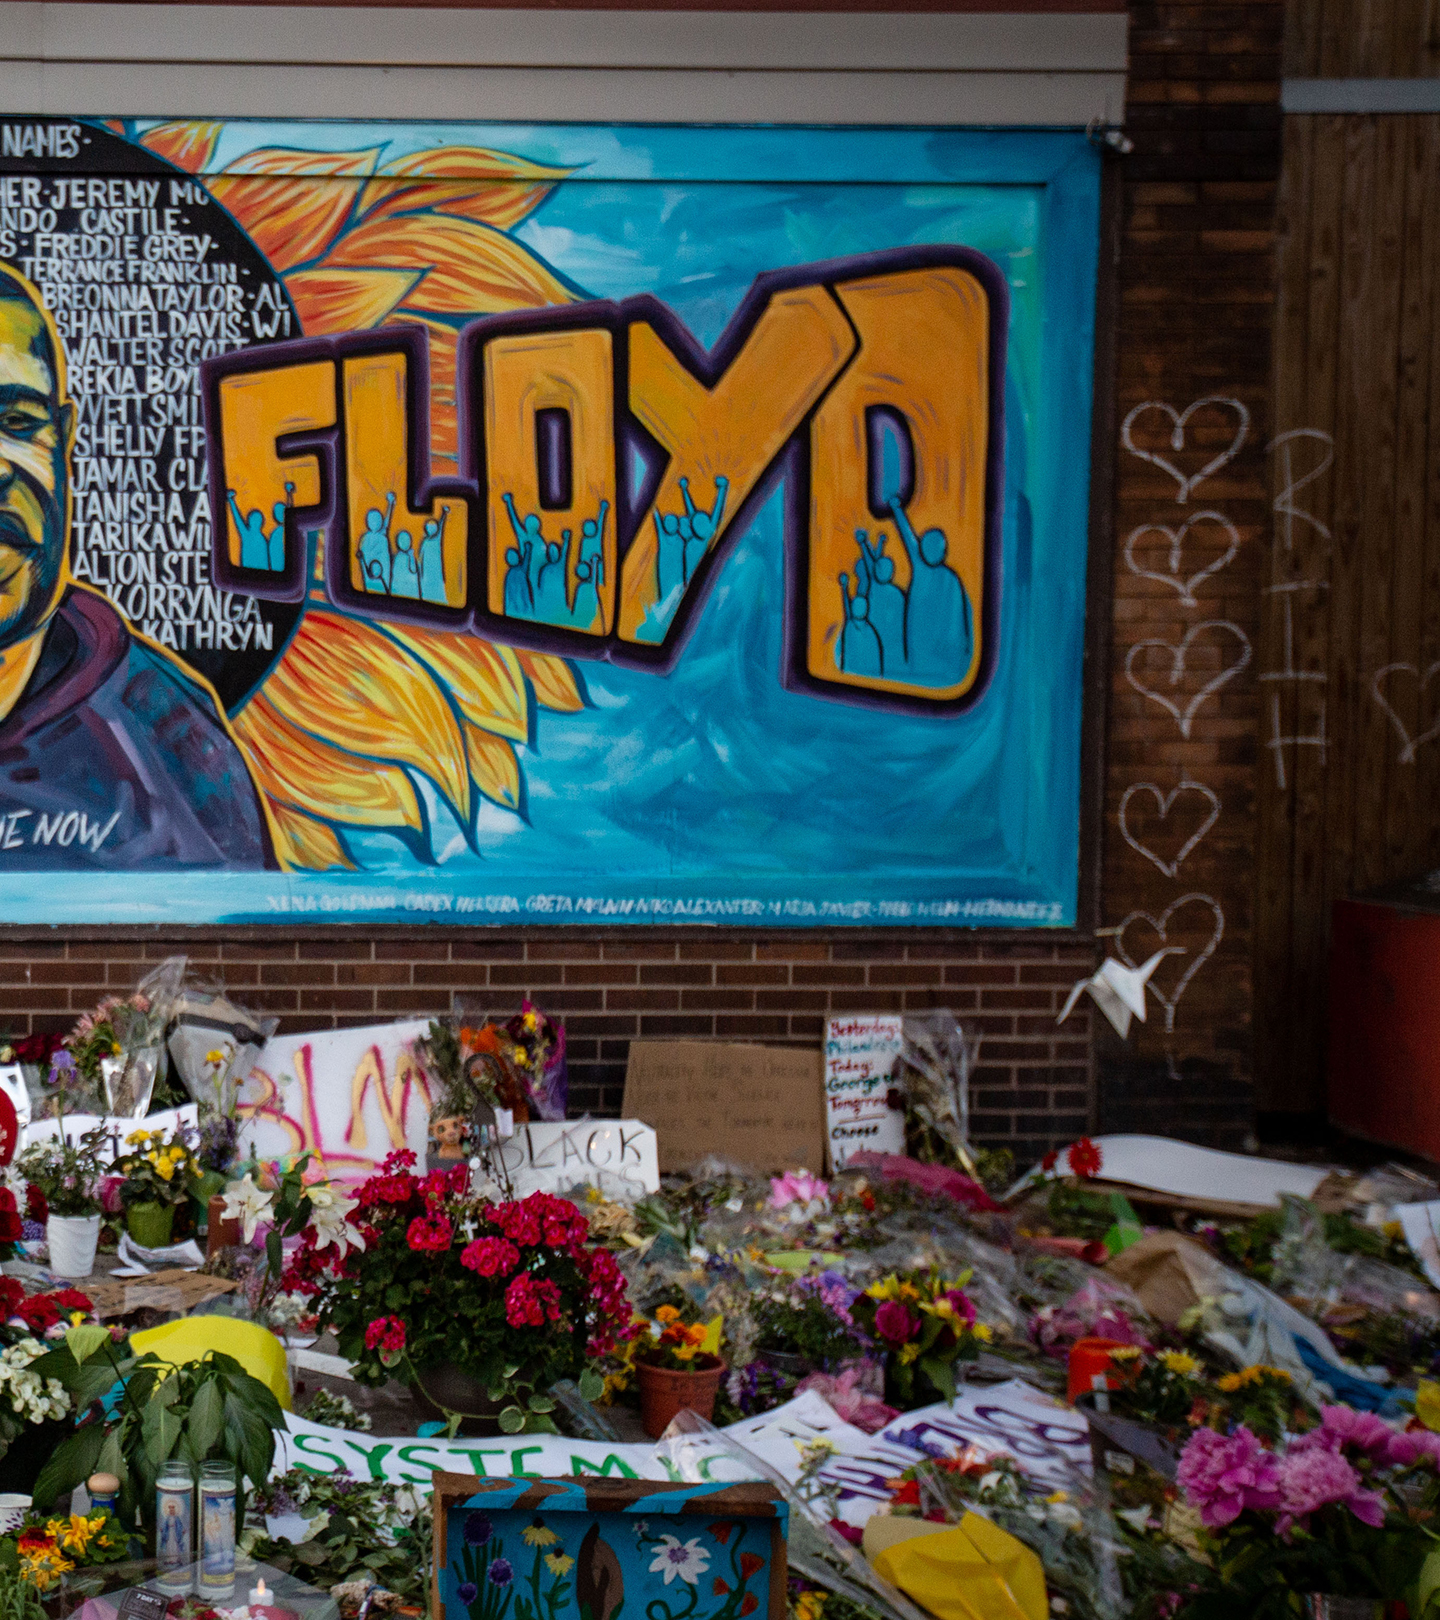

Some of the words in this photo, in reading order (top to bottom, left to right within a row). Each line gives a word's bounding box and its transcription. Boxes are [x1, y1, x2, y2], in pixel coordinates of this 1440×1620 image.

[2, 123, 81, 158] NAMES
[50, 180, 162, 209] JEREMY
[80, 208, 182, 236] CASTILE
[35, 234, 138, 260] FREDDIE
[143, 235, 211, 263] GREY
[19, 257, 124, 283] TERRANCE
[127, 260, 237, 285] FRANKLIN
[41, 283, 153, 312] BREONNA
[152, 284, 246, 312] TAYLOR
[257, 282, 289, 310] AL
[55, 310, 167, 339] SHANTEL
[170, 311, 243, 339] DAVIS
[251, 310, 291, 338] WI
[61, 337, 165, 367] WALTER
[67, 366, 139, 395] REKIA
[149, 393, 199, 428] SMI
[73, 423, 166, 458] SHELLY
[69, 457, 163, 492] JAMAR
[215, 262, 995, 705] FLOYD
[72, 490, 185, 524] TANISHA
[72, 522, 170, 552] TARIKA
[72, 550, 157, 585] ALTON
[162, 551, 208, 585] STE
[143, 619, 274, 651] KATHRYN
[33, 809, 122, 853] NOW
